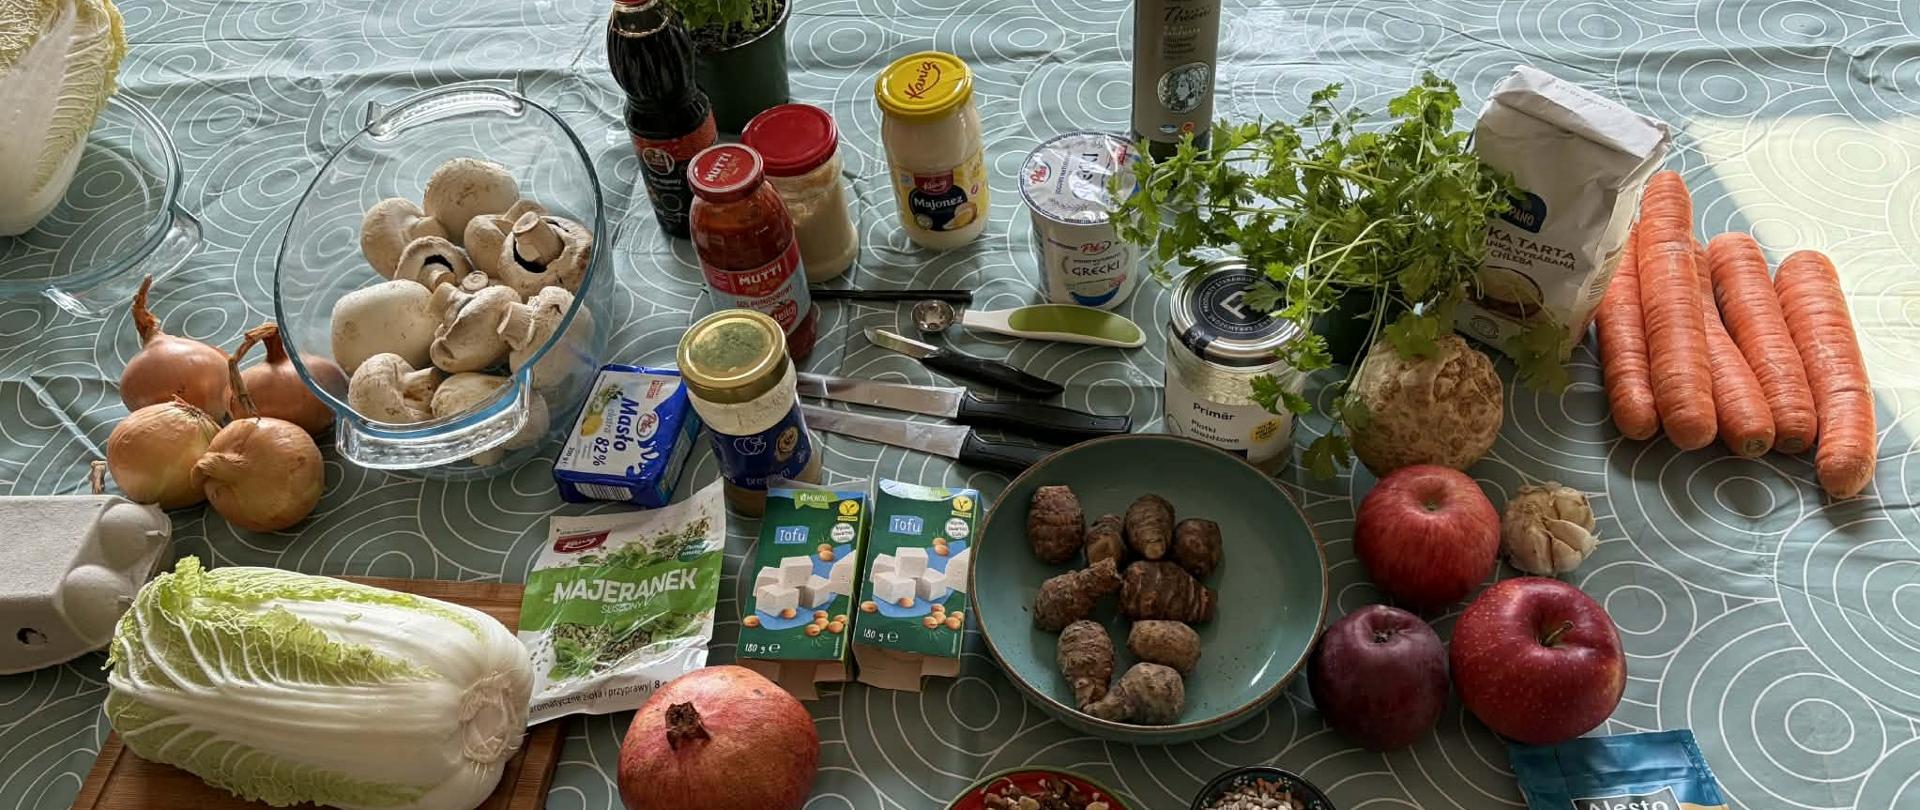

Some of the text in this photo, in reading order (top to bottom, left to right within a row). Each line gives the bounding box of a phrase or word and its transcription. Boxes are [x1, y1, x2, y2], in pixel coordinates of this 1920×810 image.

[904, 61, 940, 99] Kania
[705, 152, 732, 182] MUTTI
[914, 195, 963, 210] Majonez
[1518, 237, 1576, 261] TARTA
[738, 263, 782, 286] MUTTI
[1072, 261, 1120, 277] GRECKI
[1192, 401, 1236, 421] Primär
[613, 397, 640, 452] Masło
[592, 436, 610, 467] 82%
[779, 529, 806, 543] Tofu
[893, 518, 922, 534] Tofu
[552, 567, 698, 604] MAJERANEK
[863, 627, 876, 640] 180
[745, 642, 758, 653] 180
[608, 682, 650, 700] przyprawy
[654, 679, 661, 690] 8
